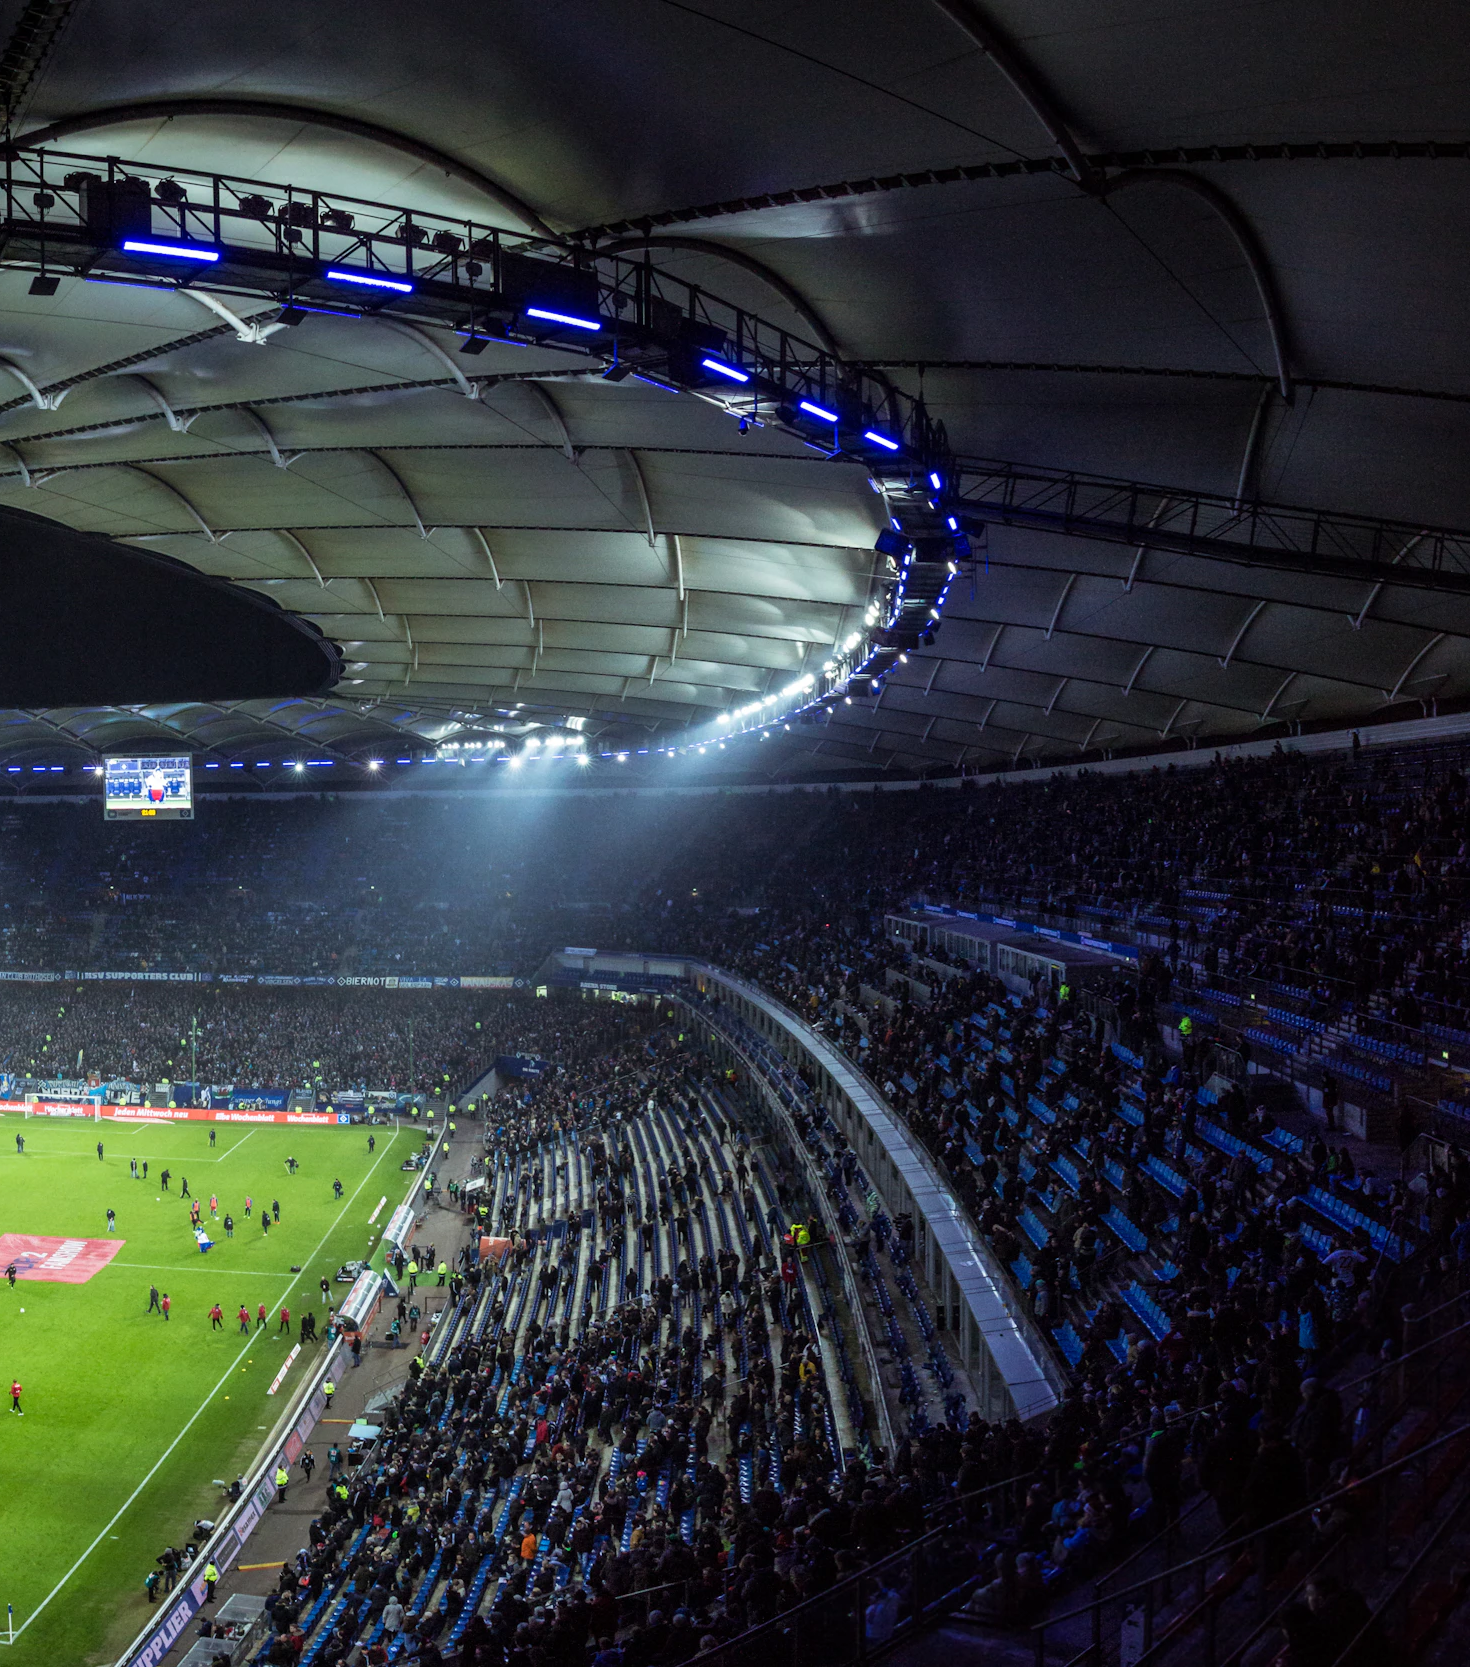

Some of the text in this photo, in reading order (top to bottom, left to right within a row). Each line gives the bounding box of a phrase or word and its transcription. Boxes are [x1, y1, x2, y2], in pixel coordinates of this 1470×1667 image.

[105, 972, 168, 980] SUPPORTERS
[169, 973, 193, 981] CLUB
[346, 977, 385, 986] BIERNOT
[136, 1108, 173, 1118] Mittwoch
[231, 1113, 275, 1122] Wochenblatt
[287, 1115, 329, 1123] Wochenblatt
[21, 1251, 49, 1259] 2
[39, 1239, 88, 1270] FANSHOW
